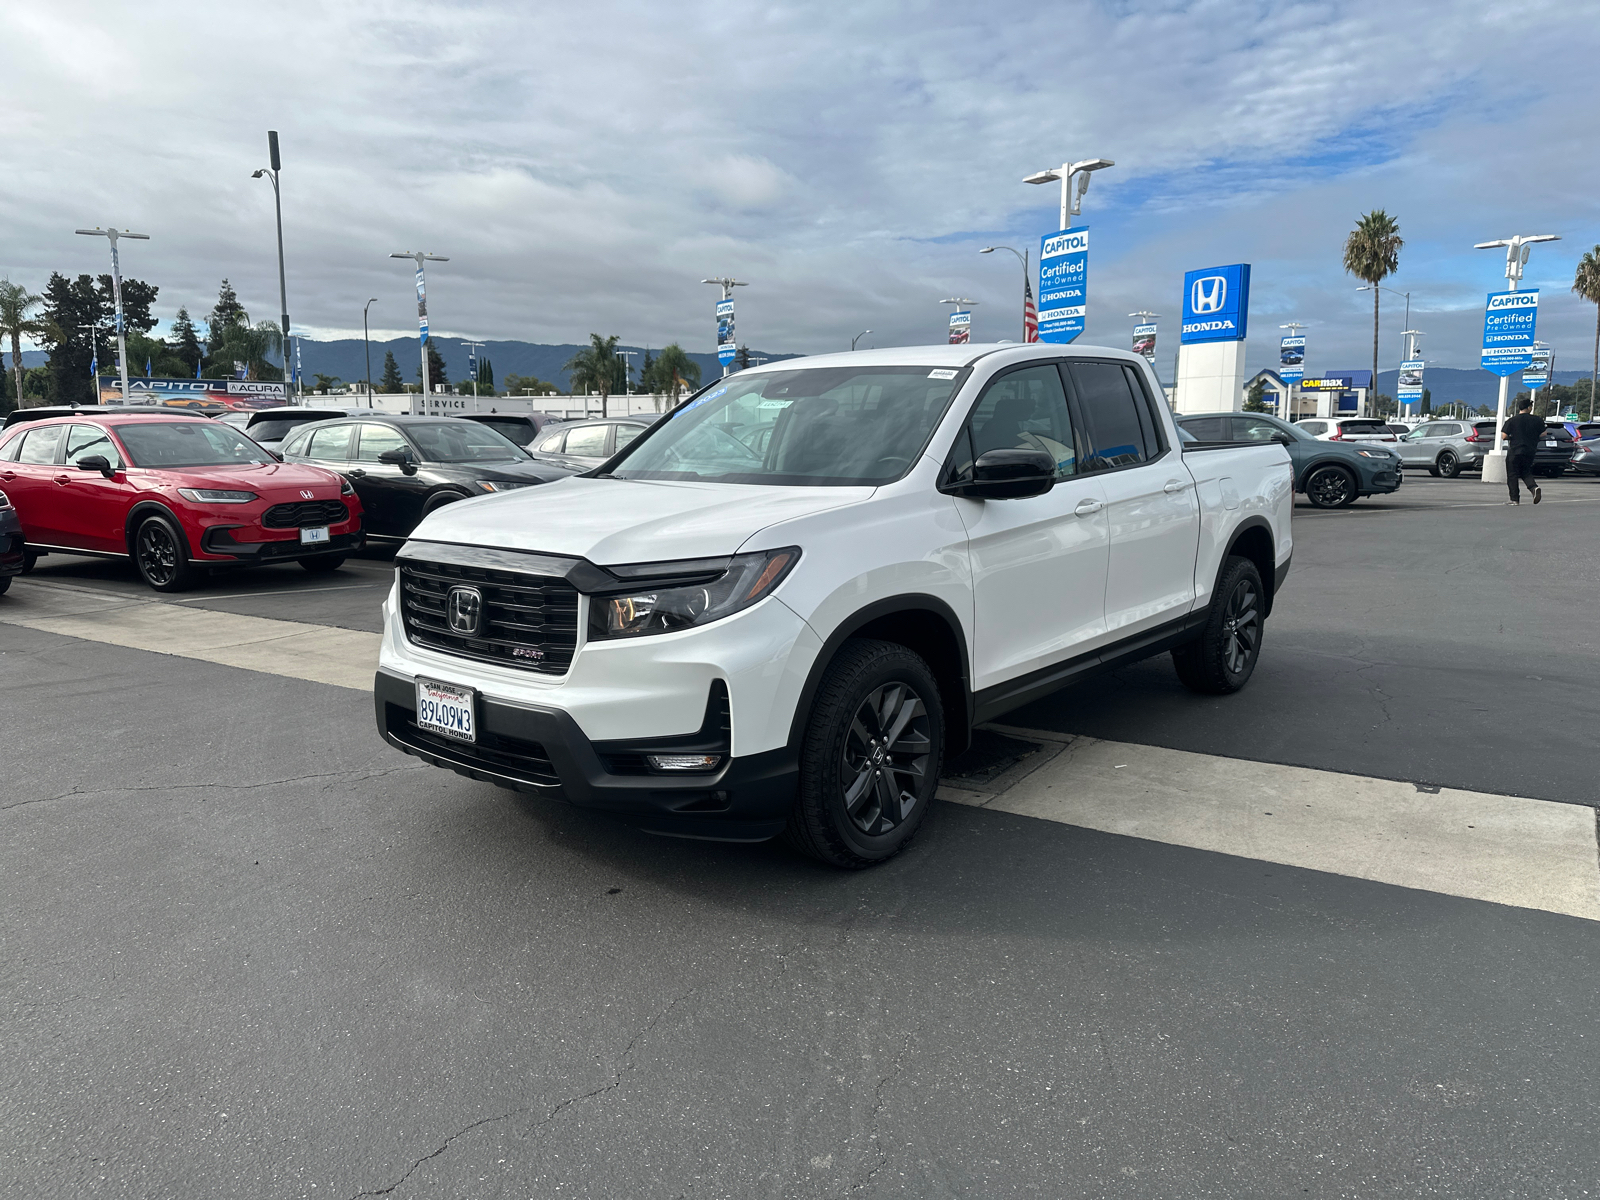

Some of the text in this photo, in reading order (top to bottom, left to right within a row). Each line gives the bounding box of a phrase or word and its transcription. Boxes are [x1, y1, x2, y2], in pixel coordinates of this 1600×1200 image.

[1045, 236, 1086, 254] CAPITOL
[1041, 259, 1084, 278] Certified
[1041, 273, 1083, 287] Pre-Owned
[1047, 290, 1082, 301] HONDA
[1491, 296, 1536, 307] CAPITOL
[1047, 309, 1080, 318] HONDA
[1487, 313, 1533, 325] Certified
[1182, 320, 1235, 333] HONDA
[1486, 323, 1532, 331] Pre-Owned
[1493, 334, 1530, 342] HONDA
[111, 380, 282, 393] CAPITOL ACURA
[512, 648, 544, 660] SPORT
[430, 682, 456, 694] SAN JOSE
[421, 698, 471, 732] 89409W3
[419, 720, 473, 741] CAPITOL HONDA
